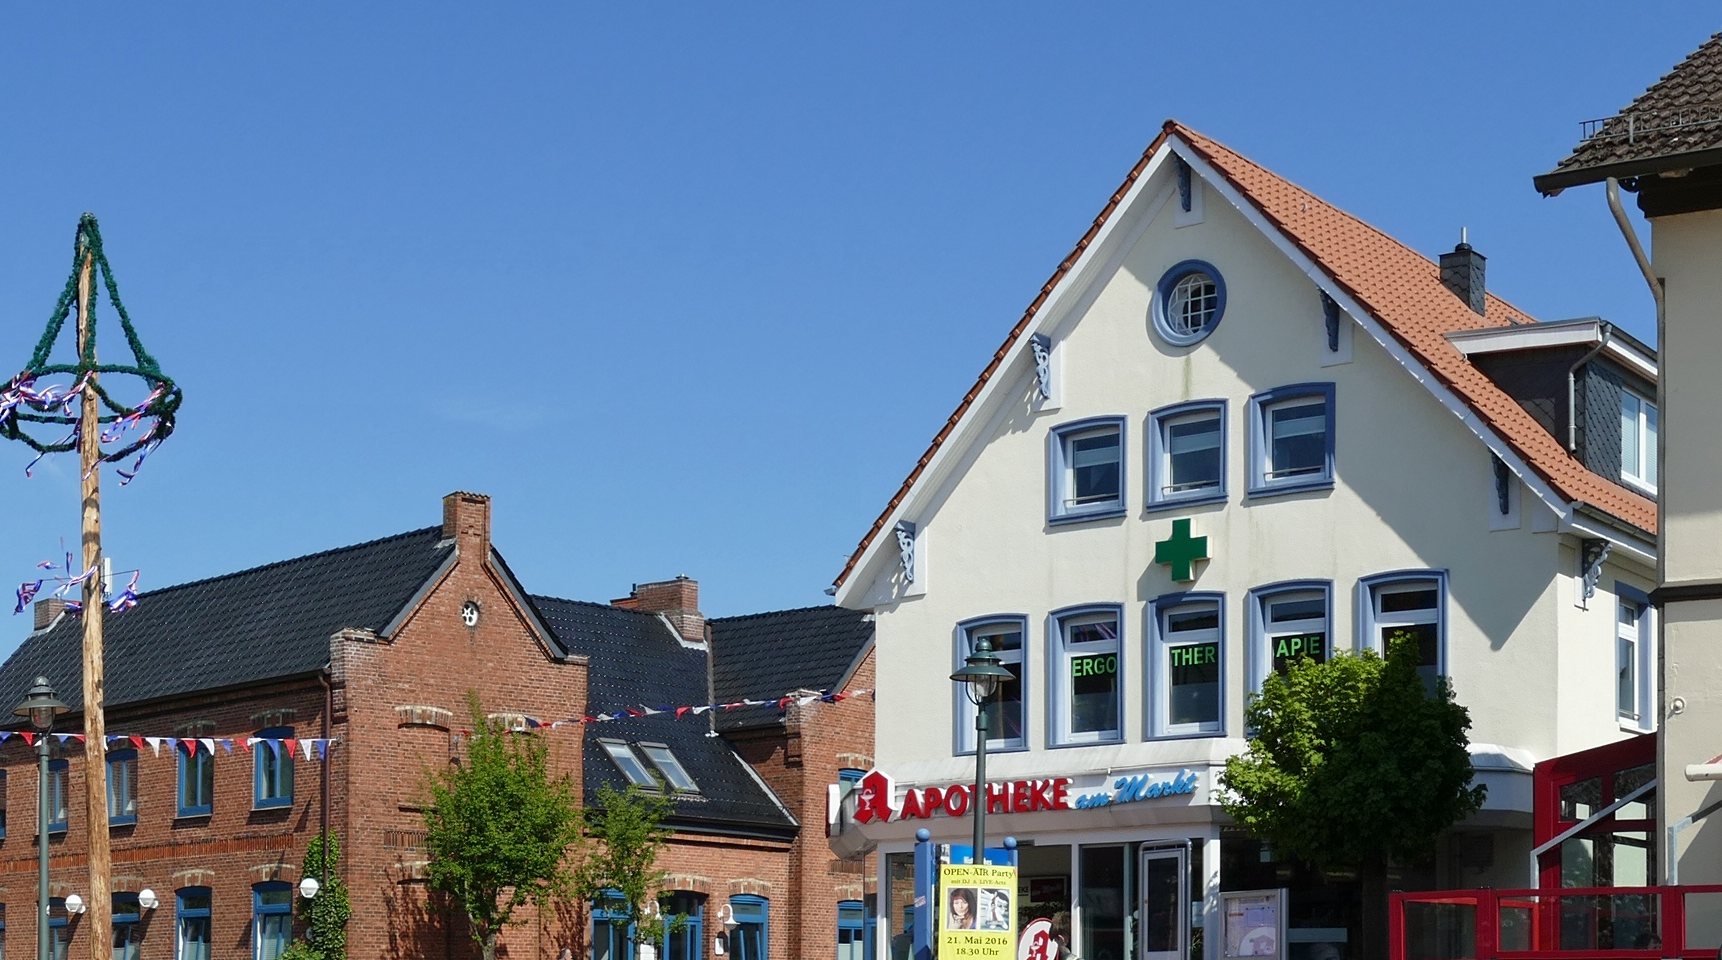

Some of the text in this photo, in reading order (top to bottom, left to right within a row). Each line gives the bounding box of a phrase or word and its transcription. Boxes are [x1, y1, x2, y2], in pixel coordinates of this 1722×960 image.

[1072, 636, 1321, 677] ERGO THER APIE
[1075, 791, 1110, 809] am
[1113, 768, 1197, 802] Markt
[943, 867, 1015, 879] OPEN-AIR Party
[947, 936, 1008, 946] 21. Mai 2016
[956, 947, 1000, 956] 18.30 Uhr
